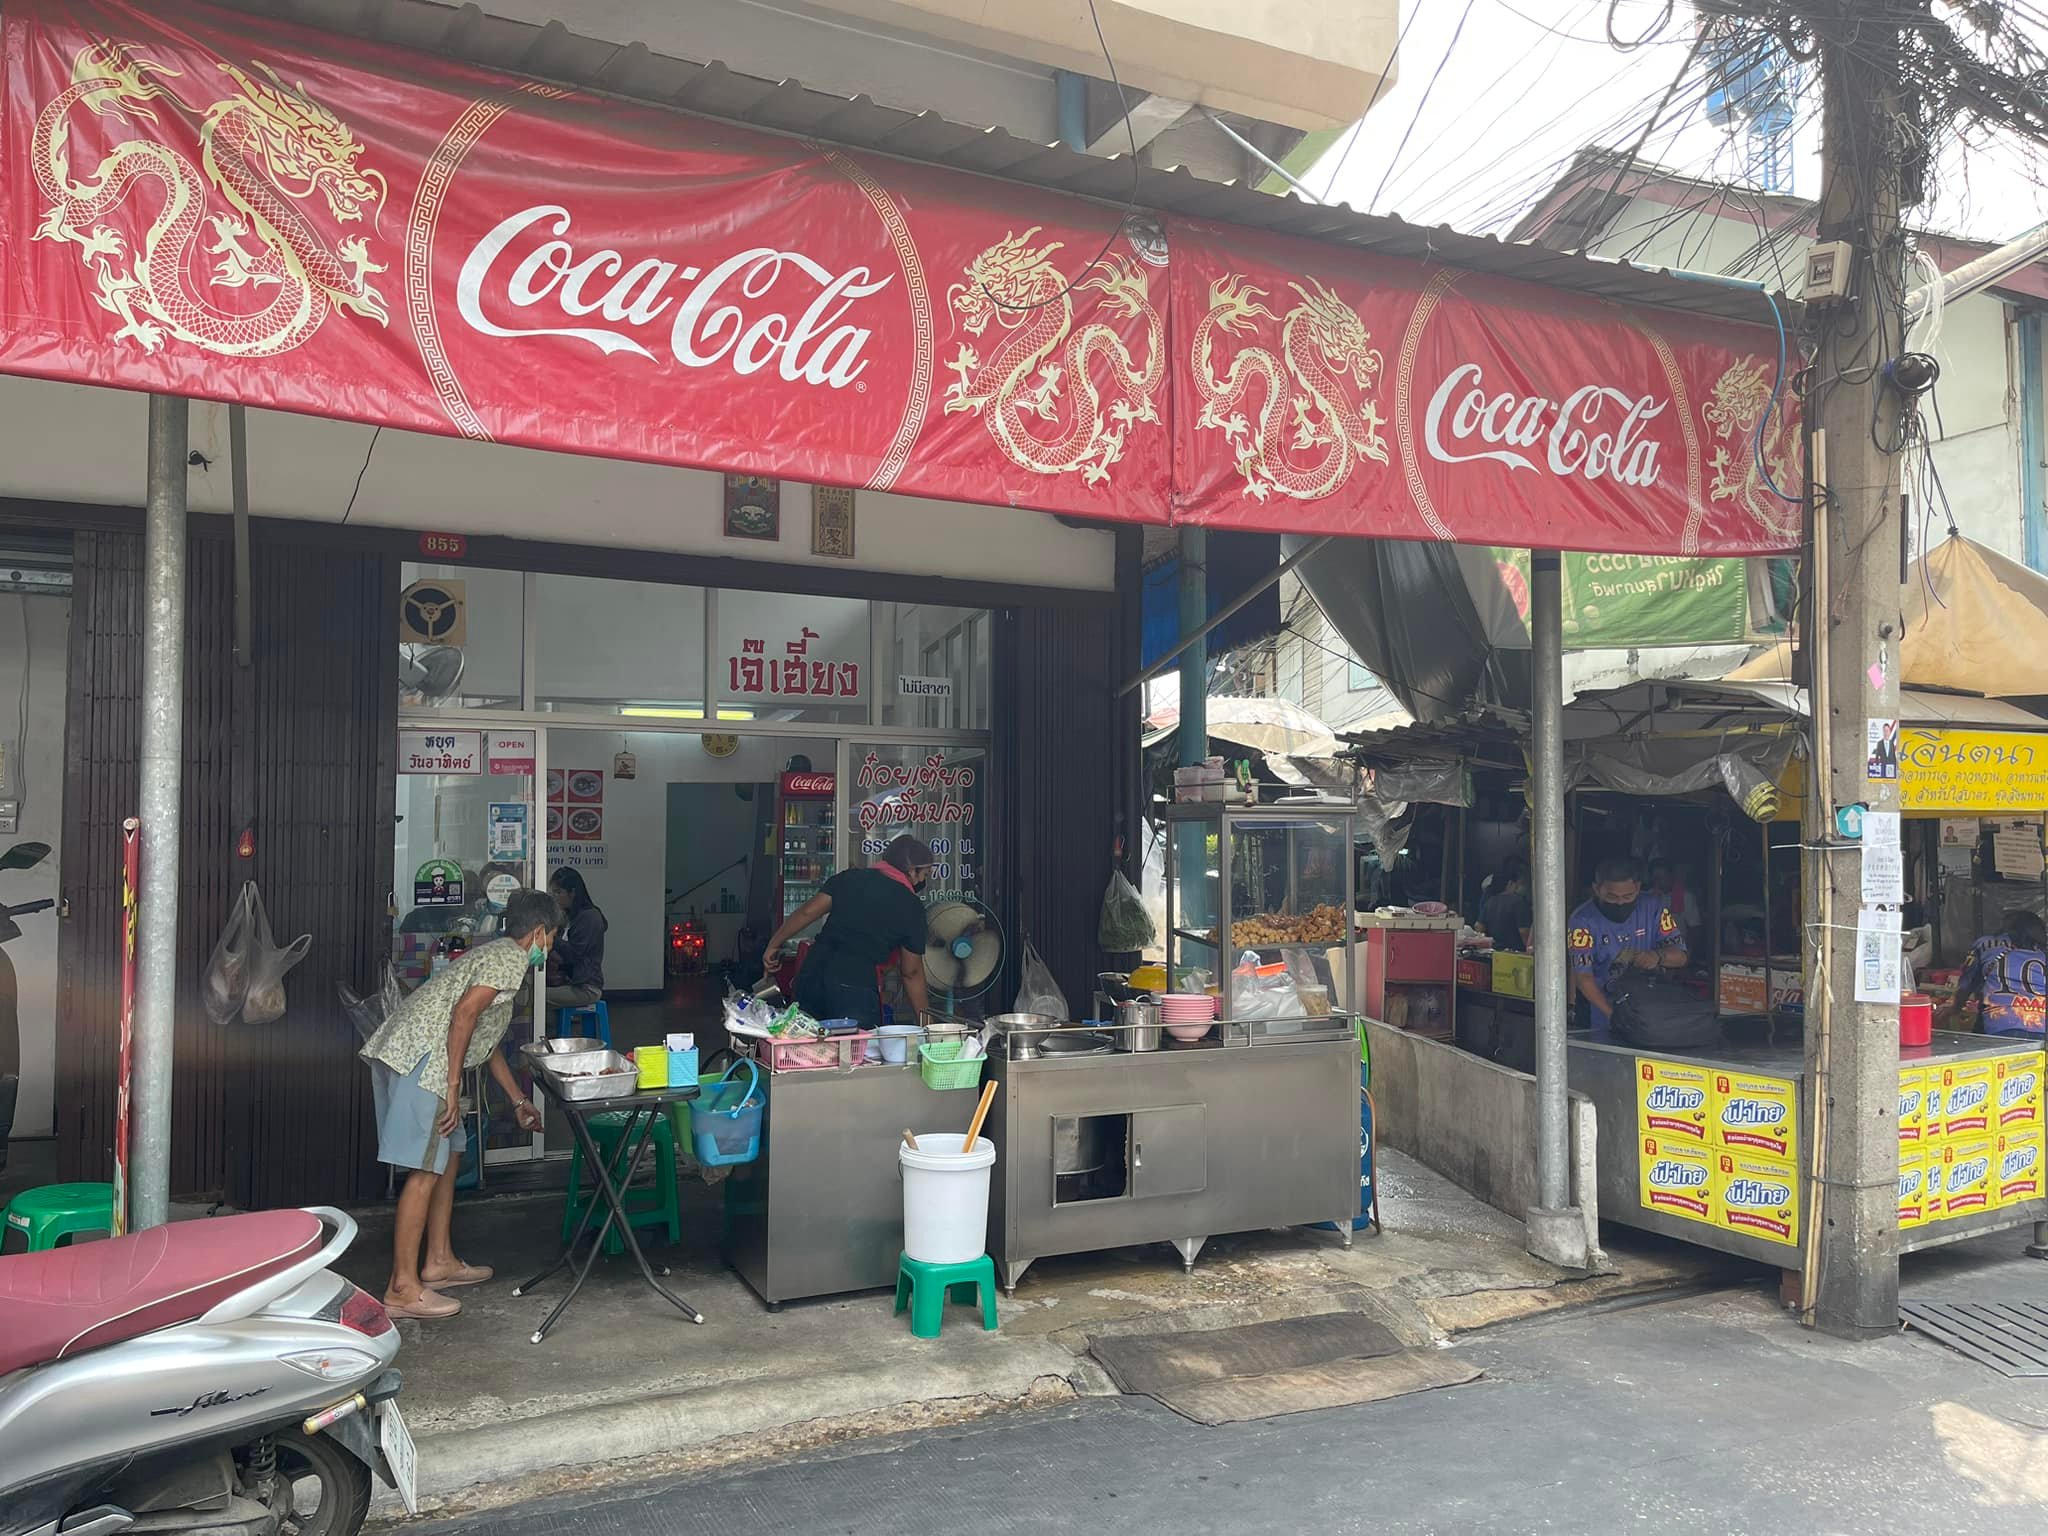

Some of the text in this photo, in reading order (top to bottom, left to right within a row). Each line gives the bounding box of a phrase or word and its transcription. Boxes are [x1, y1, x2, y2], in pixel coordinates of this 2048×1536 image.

[456, 205, 896, 389] Coca-Cola
[1424, 363, 1670, 488] Coca-Cola
[427, 537, 459, 552] 855
[728, 626, 860, 698] เจ๊เฮี้ยง
[899, 676, 951, 696] ไม่มีสาขา
[424, 735, 456, 754] หยุด
[497, 740, 525, 749] OPEN
[409, 753, 473, 770] วันอาทิตย์
[857, 751, 975, 790] ก๋วยเตี๋ยว
[858, 787, 975, 833] ลูกชิ้นปลา
[930, 837, 951, 855] 60
[930, 861, 951, 880] 70
[1650, 1085, 1703, 1109] ฟ้าไทย
[1948, 1083, 1987, 1113] ฟ้าไทย
[2001, 1075, 2034, 1104] ฟ้าไทย
[1725, 1098, 1785, 1124] ฟ้าไทย
[1653, 1160, 1706, 1185] ฟ้าไทย
[1948, 1159, 1987, 1190] ฟ้าไทย
[1729, 1179, 1789, 1205] ฟ้าไทย
